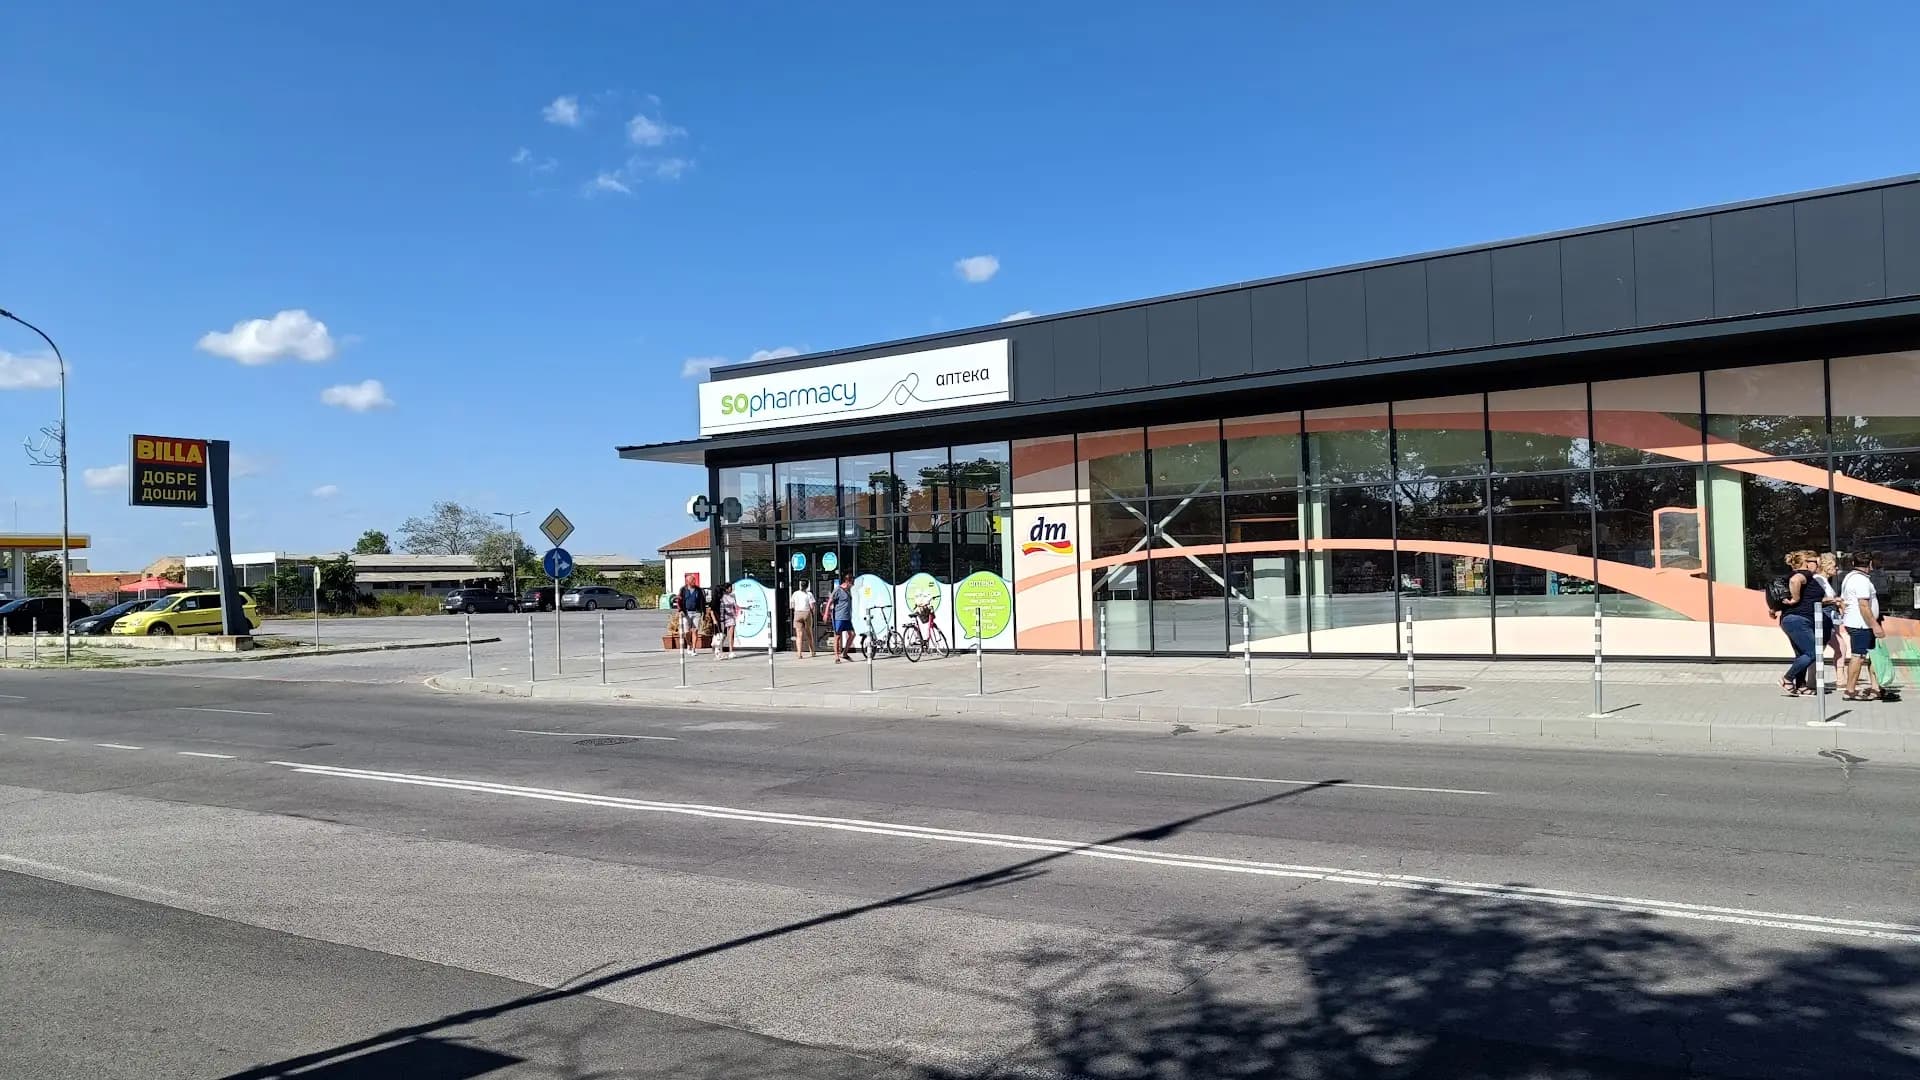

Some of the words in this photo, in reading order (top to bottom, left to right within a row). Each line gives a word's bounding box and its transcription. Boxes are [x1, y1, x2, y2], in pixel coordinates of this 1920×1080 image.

[936, 367, 990, 387] аптека
[721, 382, 857, 417] sopharmacy
[137, 439, 203, 464] BILLA
[142, 470, 197, 486] ДОБРЕ
[142, 487, 197, 501] ДОШЛИ
[1030, 516, 1067, 541] dm
